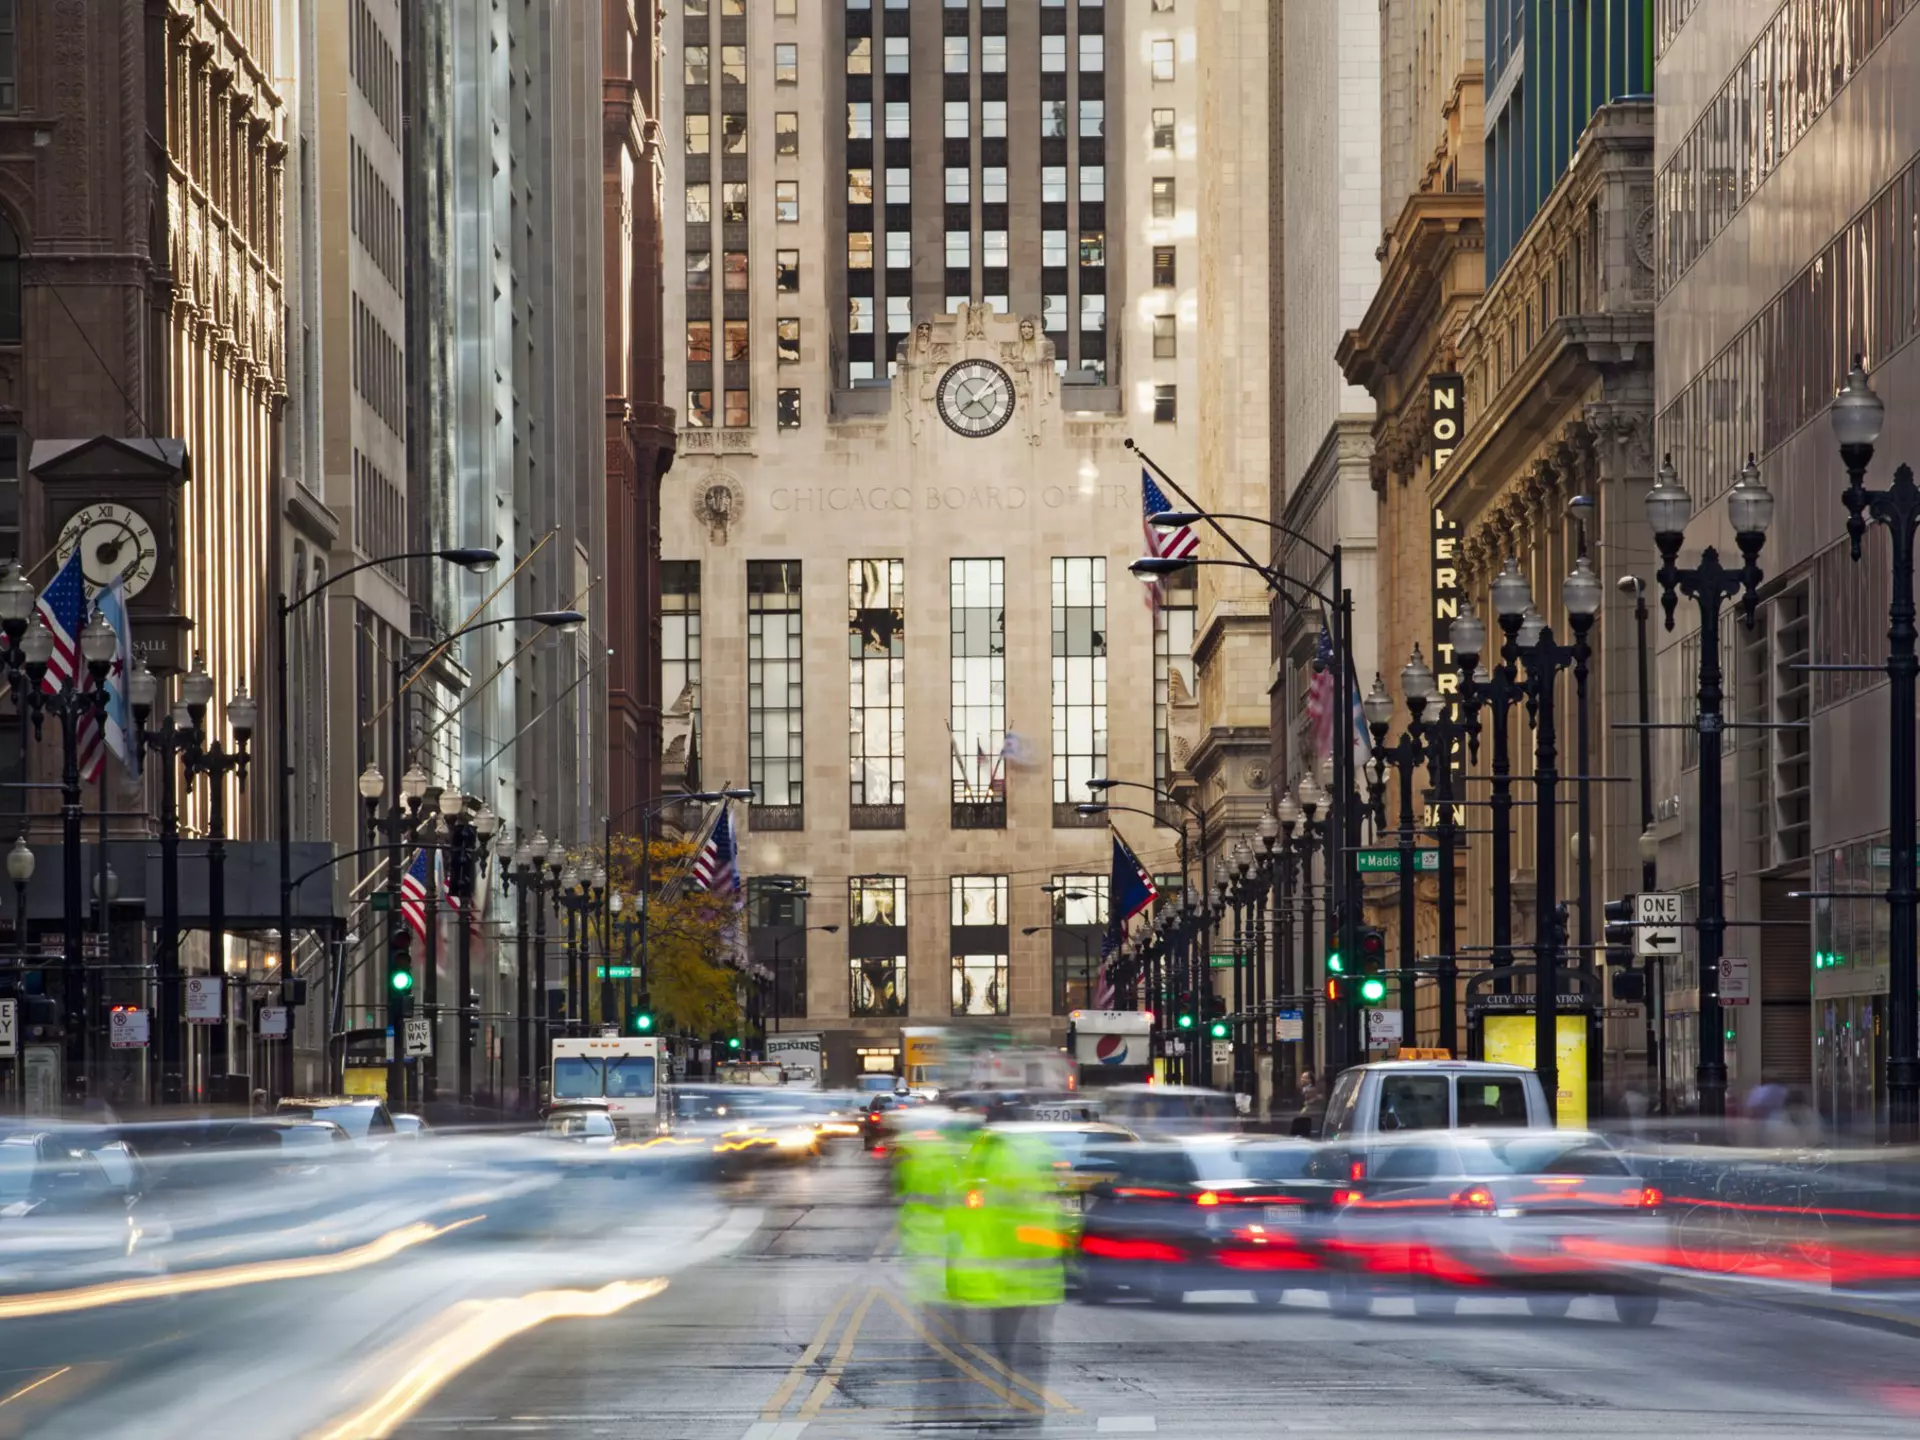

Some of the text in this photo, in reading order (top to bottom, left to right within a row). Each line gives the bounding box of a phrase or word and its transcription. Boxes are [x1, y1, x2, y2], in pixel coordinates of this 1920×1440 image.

[769, 487, 912, 511] CHICAGO
[926, 486, 1026, 509] BOARD
[1367, 854, 1402, 867] Madis
[1644, 898, 1677, 912] ONE
[1643, 914, 1677, 929] WAY
[1486, 994, 1512, 1004] CITY
[408, 1022, 429, 1031] ONE
[408, 1031, 428, 1041] WAY
[768, 1041, 820, 1054] BEKINS
